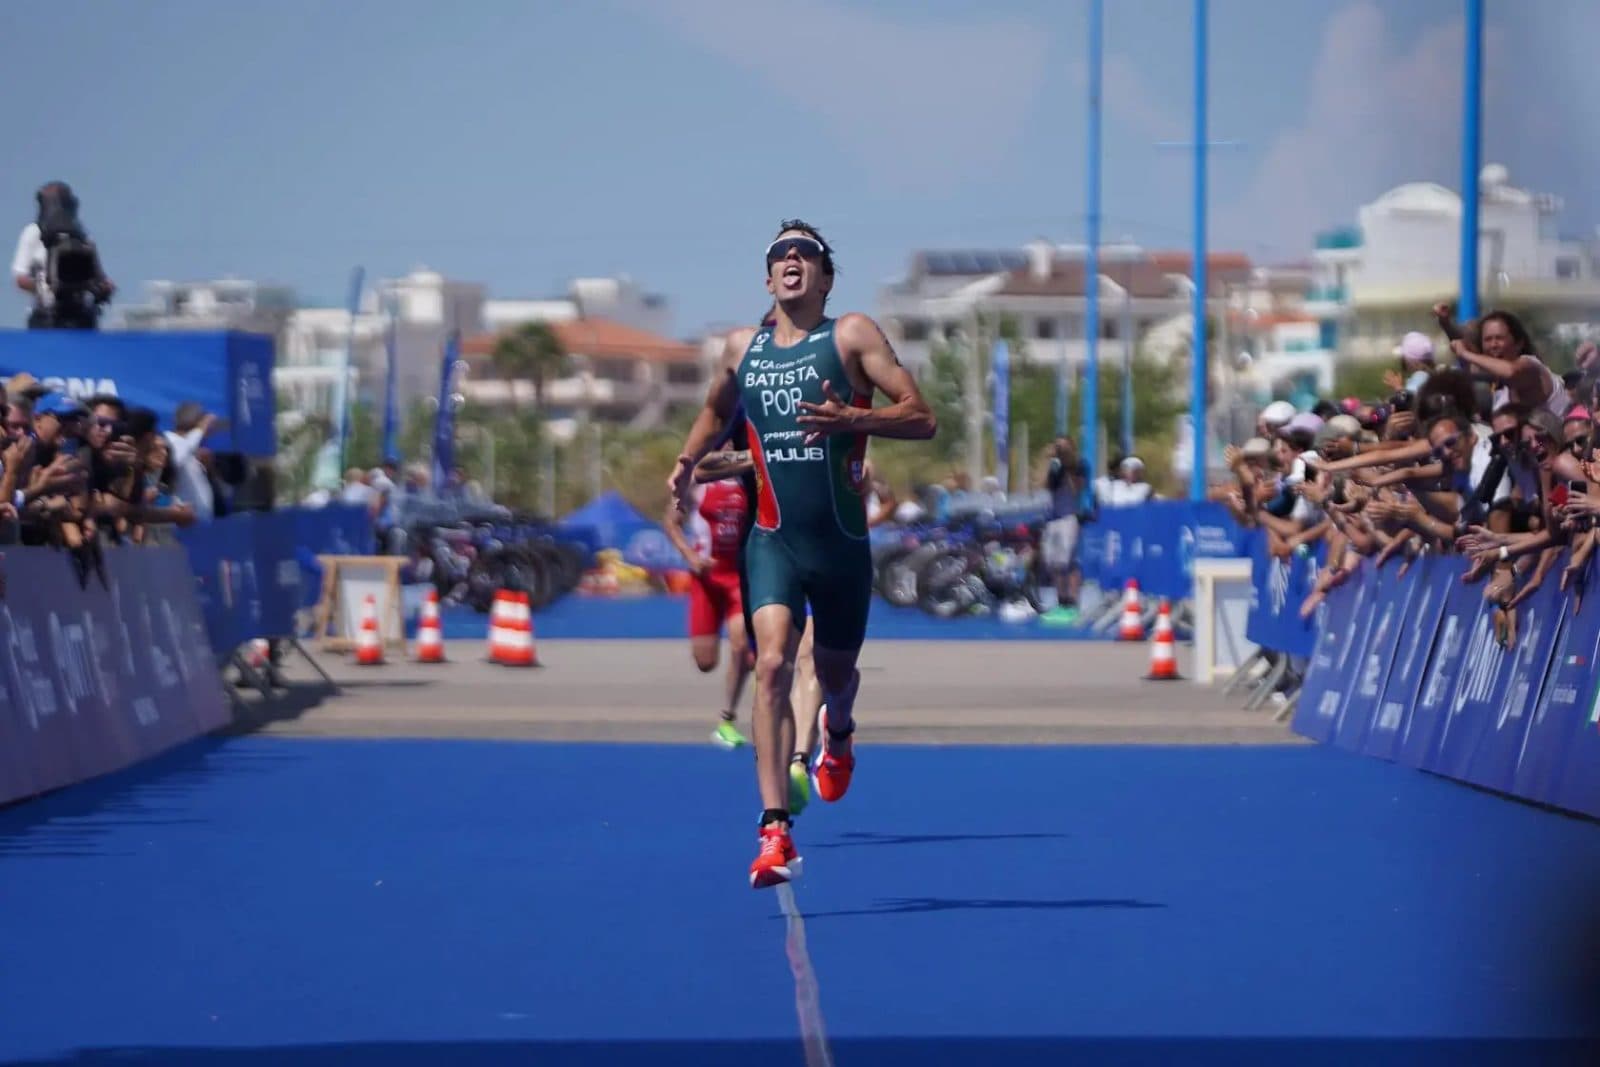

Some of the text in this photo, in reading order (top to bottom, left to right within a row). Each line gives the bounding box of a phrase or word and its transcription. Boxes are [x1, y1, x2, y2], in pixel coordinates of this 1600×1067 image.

[760, 360, 775, 369] CA
[745, 365, 819, 388] BATISTA
[761, 387, 807, 417] POR
[765, 447, 825, 463] HUUB
